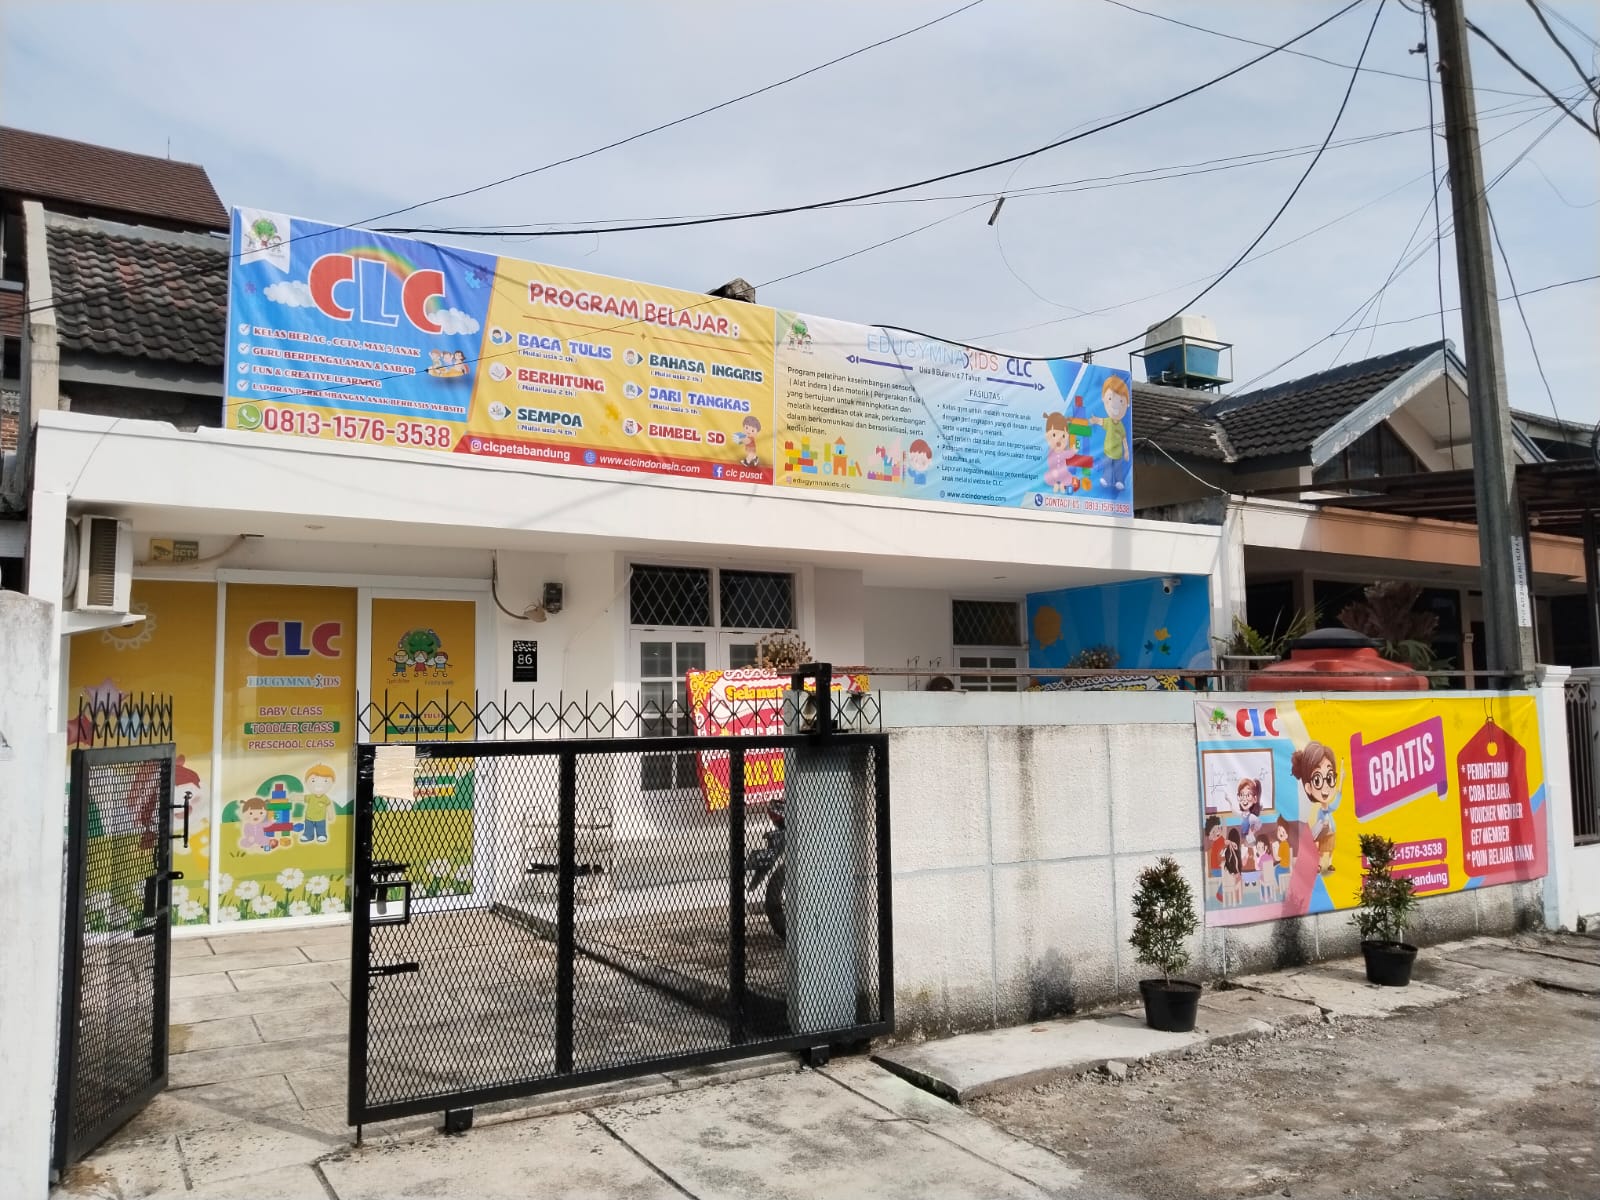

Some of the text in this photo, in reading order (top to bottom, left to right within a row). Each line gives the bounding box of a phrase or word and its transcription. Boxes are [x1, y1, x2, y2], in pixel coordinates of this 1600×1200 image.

[308, 253, 445, 334] CLC
[530, 284, 639, 319] PROGRAM
[254, 327, 287, 339] KELAS
[288, 333, 309, 341] BER
[364, 341, 385, 351] MAX
[386, 345, 393, 353] 5
[394, 346, 420, 357] ANAK
[518, 334, 612, 359] BACA TULIS
[253, 347, 415, 374] GURU BERPENGALAMAN & SABAR
[649, 354, 763, 383] BAHASA INGGRIS
[1006, 358, 1032, 378] CLC
[253, 366, 382, 388] FUN & CREATIVE LEARNING
[518, 369, 605, 392] BERHITUNG
[787, 366, 816, 377] Program
[817, 371, 846, 382] pelatihan
[253, 384, 465, 413] LAPORAN PERKEMBANGAN ANAK BERBASIS WEBSITE
[649, 387, 750, 412] JARI TANGKAS
[832, 385, 845, 393] dan
[845, 388, 869, 397] motorik
[787, 390, 803, 399] yang
[804, 391, 836, 403] bertujuan
[836, 396, 855, 406] untuk
[900, 405, 911, 413] dan
[787, 401, 812, 411] melatih
[812, 404, 848, 416] kecerdasan
[849, 410, 863, 418] otak
[264, 408, 450, 447] 0813-1576-3538
[517, 408, 582, 427] SEMPOA
[787, 412, 807, 421] dalam
[808, 415, 855, 428] berkomunikasi
[855, 421, 867, 429] dan
[649, 424, 725, 444] BIMBEL SD
[483, 440, 570, 462] clcpetabandung
[599, 455, 701, 473] www.clcindonesia.com
[726, 469, 763, 480] clc pusat
[1045, 497, 1071, 507] CONTACT
[248, 620, 342, 658] CLC
[517, 654, 533, 665] 86
[725, 685, 784, 702] Selamat
[259, 706, 323, 716] BABY CLASS
[252, 722, 335, 734] TODDLER CLASS
[1236, 708, 1280, 737] CLC
[248, 739, 335, 750] PRESCHOOL CLASS
[1369, 732, 1435, 796] GRATIS
[1467, 762, 1509, 780] PENDAFTARAN
[1468, 783, 1511, 802] COBA BELAJAR
[1470, 803, 1523, 824] VOUCHER MEMBER
[1471, 826, 1510, 846] GET MEMBER
[1471, 844, 1534, 868] POIN BELAJAR ANAK
